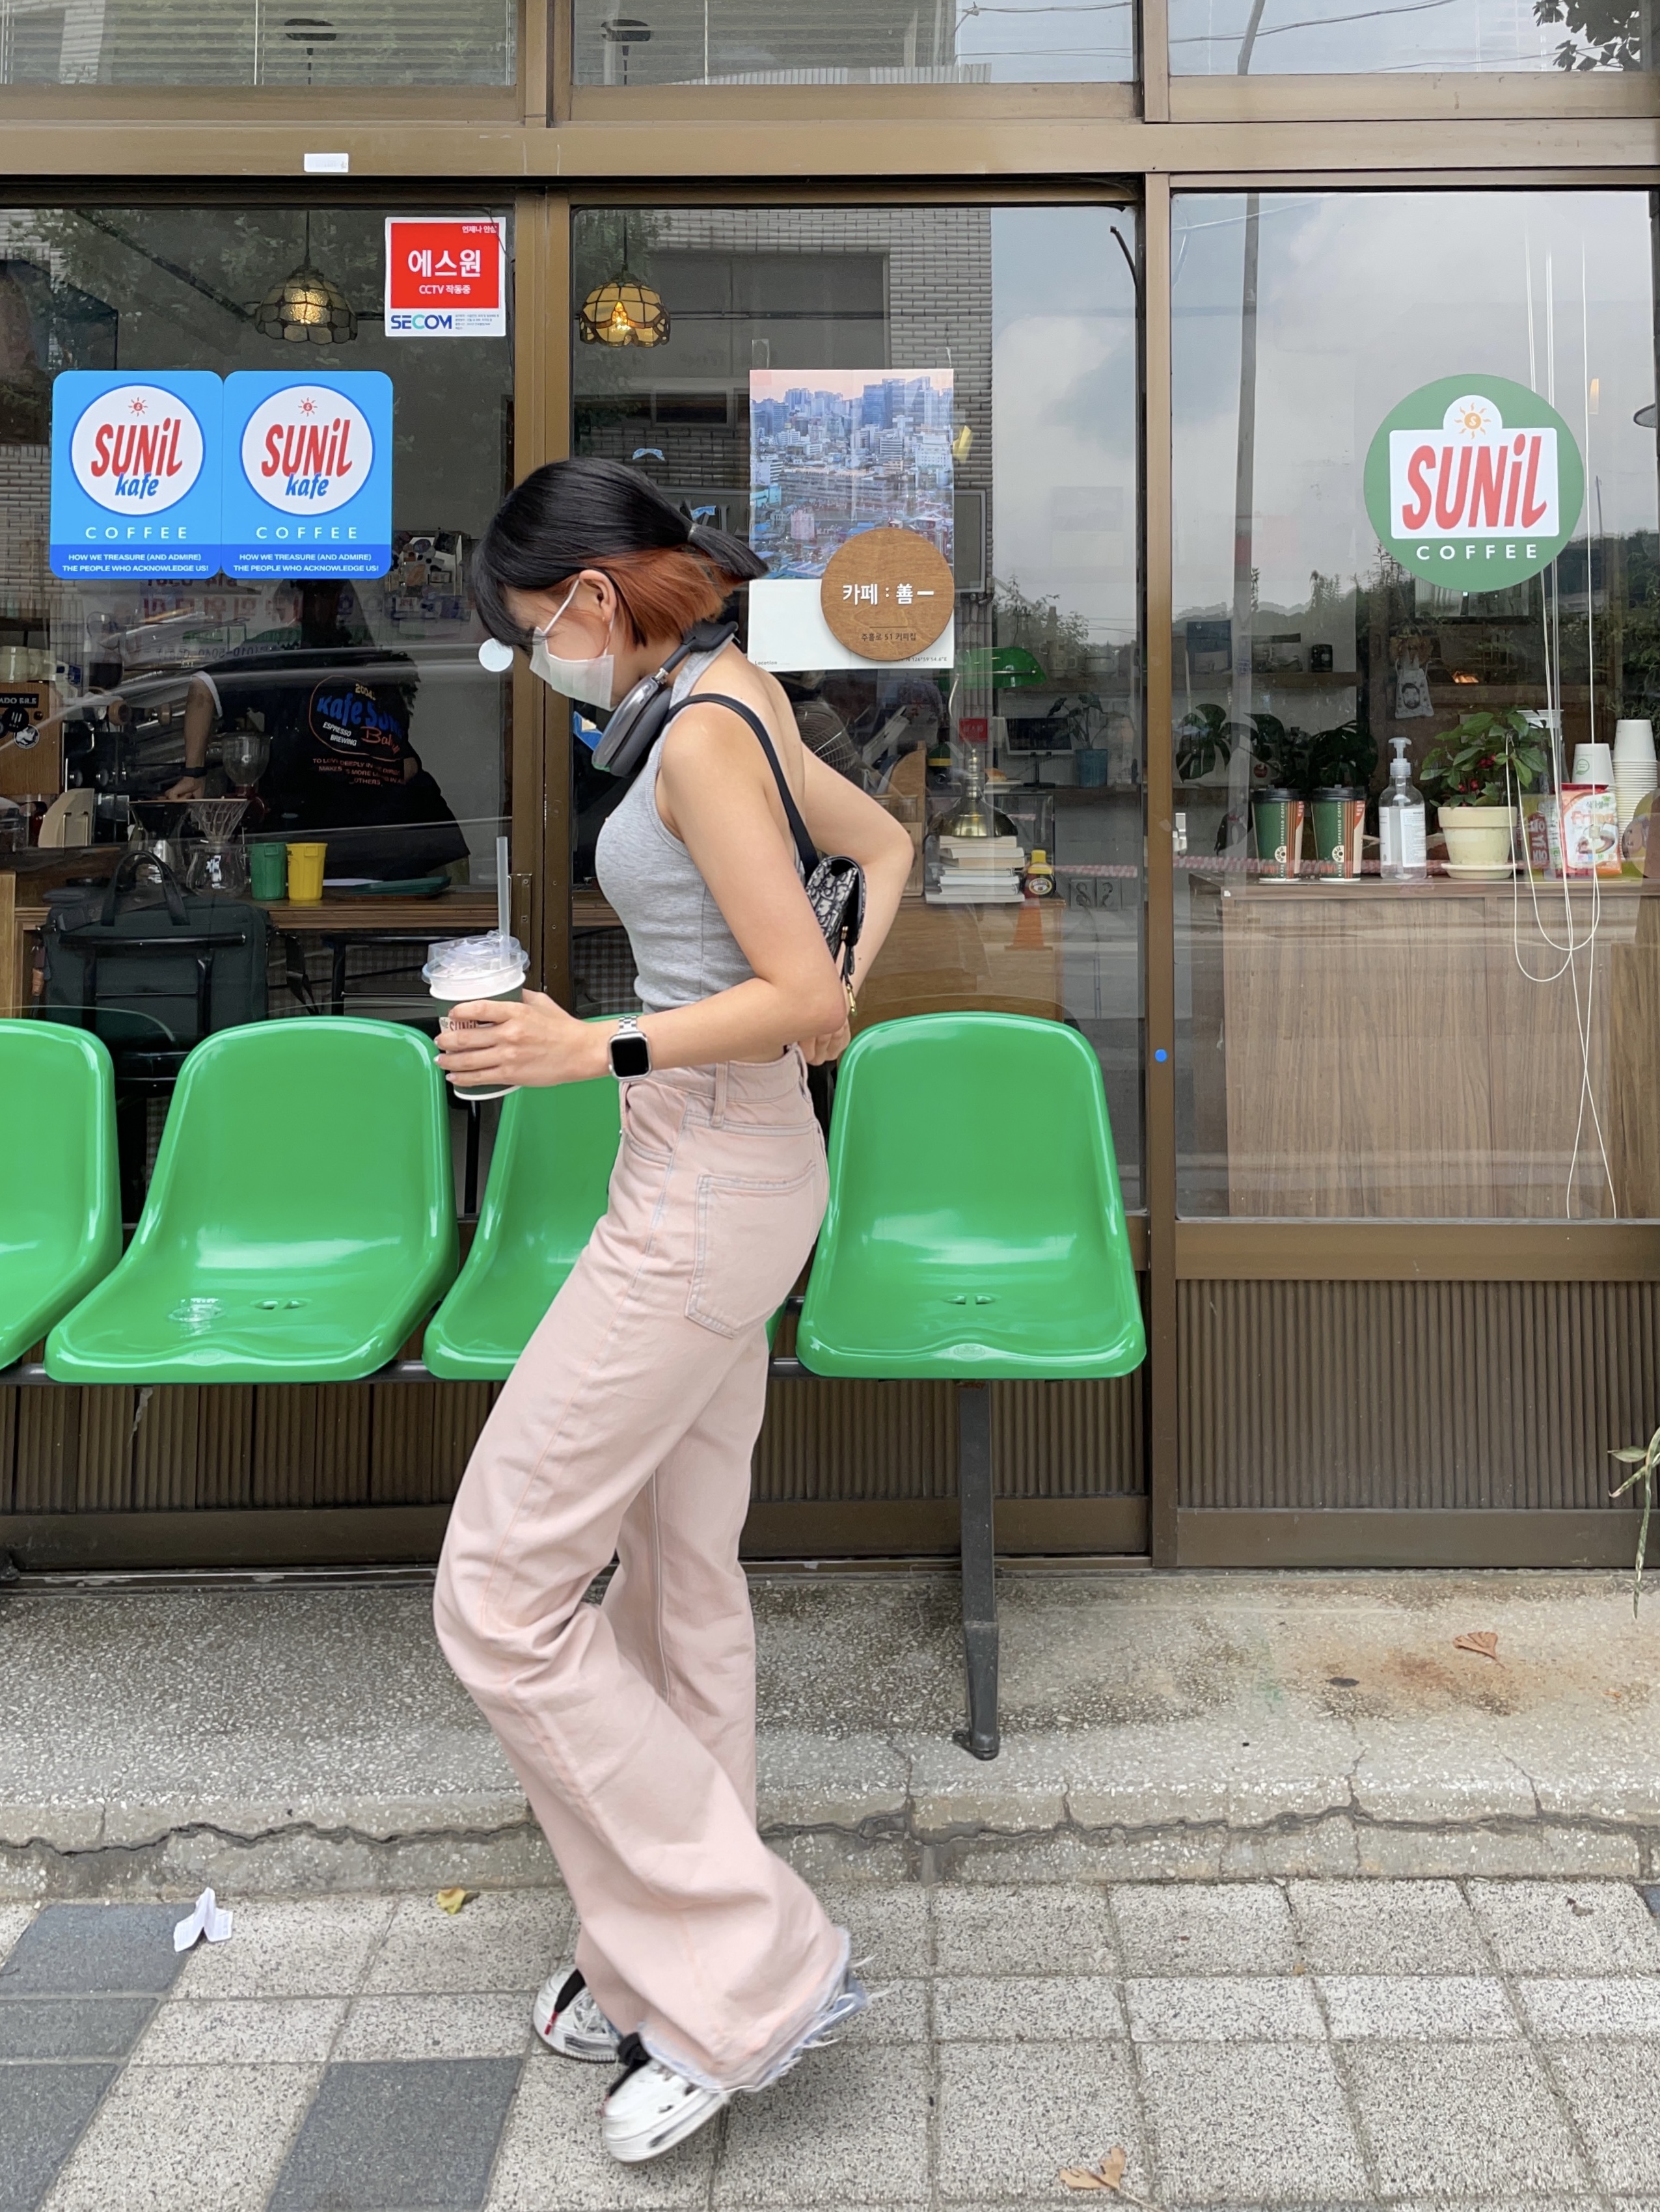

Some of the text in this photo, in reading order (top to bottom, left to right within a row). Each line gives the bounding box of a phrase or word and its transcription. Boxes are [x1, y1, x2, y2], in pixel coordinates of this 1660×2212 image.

[408, 249, 481, 277] 에스원
[419, 284, 471, 295] CCTV 작동중
[390, 314, 452, 330] SECOM
[115, 472, 159, 499] kafe
[285, 472, 329, 499] kafe
[85, 526, 187, 539] COFFEE
[256, 526, 357, 539] COFFEE
[1416, 544, 1537, 560] COFFEE
[843, 584, 878, 605] 카페
[323, 722, 352, 738] ESPRESSO
[330, 734, 357, 747] BREWING
